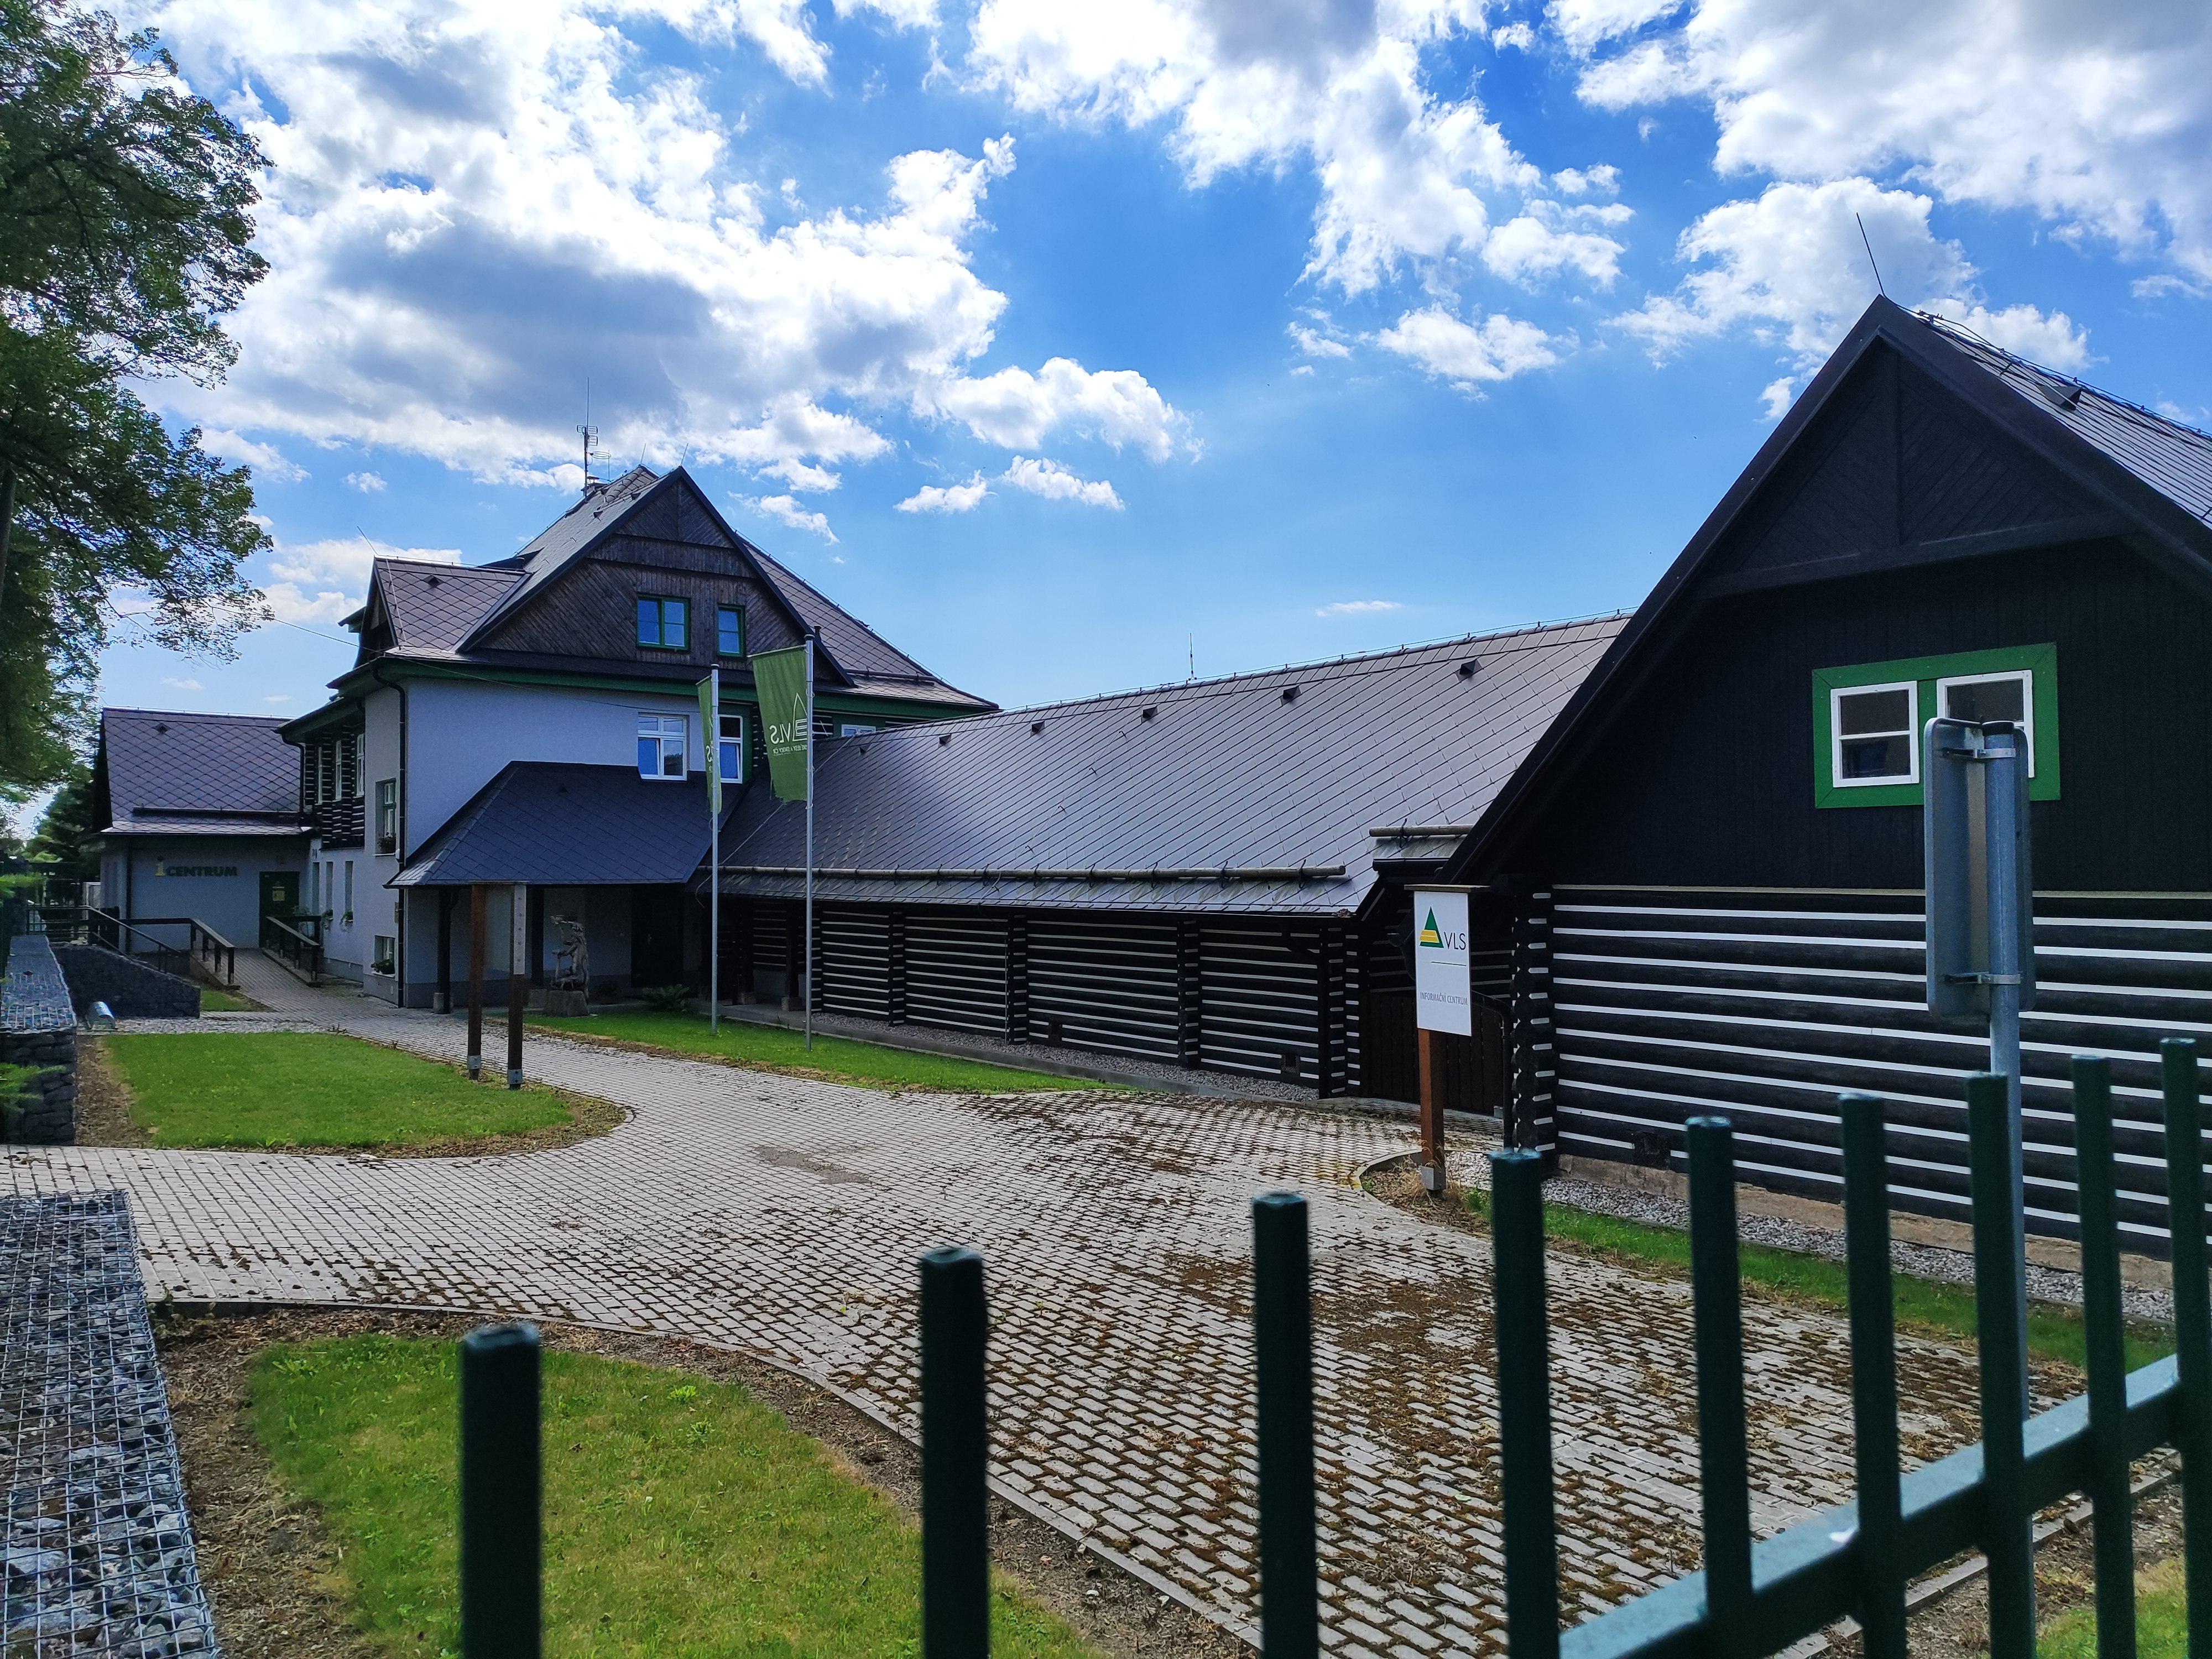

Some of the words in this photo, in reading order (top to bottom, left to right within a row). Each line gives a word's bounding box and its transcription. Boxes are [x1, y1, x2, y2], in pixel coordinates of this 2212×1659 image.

[166, 866, 238, 877] CENTRUM
[1444, 932, 1467, 950] VLS
[1420, 992, 1447, 1003] INFORMAČNÍ
[1447, 995, 1468, 1006] CENTRUM
